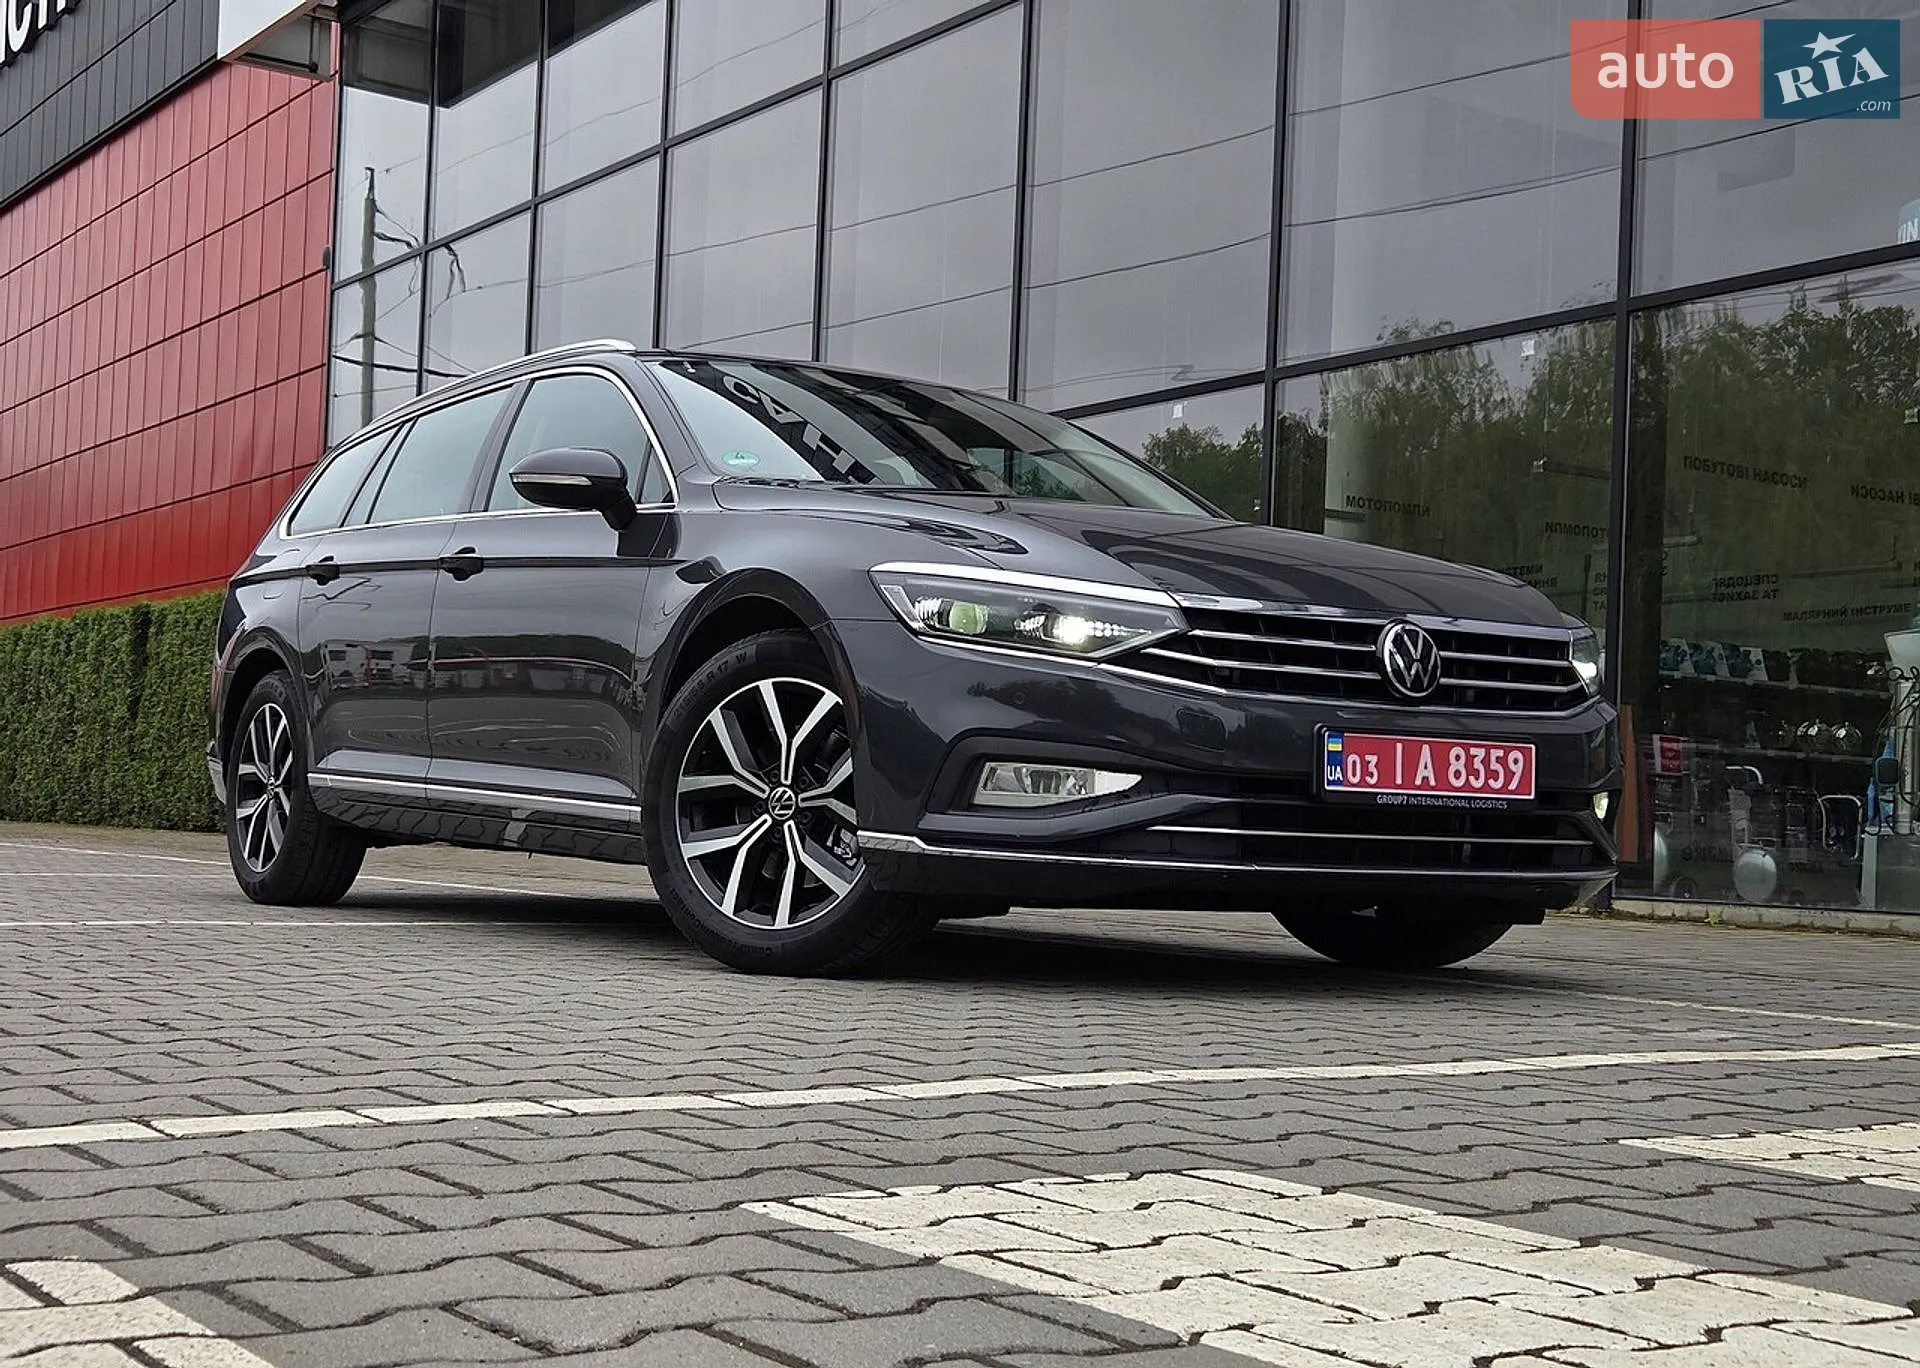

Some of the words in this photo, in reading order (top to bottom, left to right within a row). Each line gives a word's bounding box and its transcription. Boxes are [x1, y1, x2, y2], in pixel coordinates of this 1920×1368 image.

[1683, 455, 1749, 481] ПОБУТОВІ
[1753, 467, 1809, 489] НАСОСИ
[1345, 494, 1432, 518] МОТОПОМПИ
[1851, 603, 1911, 616] ІНСТРУМЕ
[1327, 765, 1344, 782] UA
[1346, 753, 1379, 786] 03
[1447, 746, 1525, 791] 8359
[1409, 796, 1470, 808] INTERNATIONAL
[1471, 800, 1508, 809] LOGISTICS
